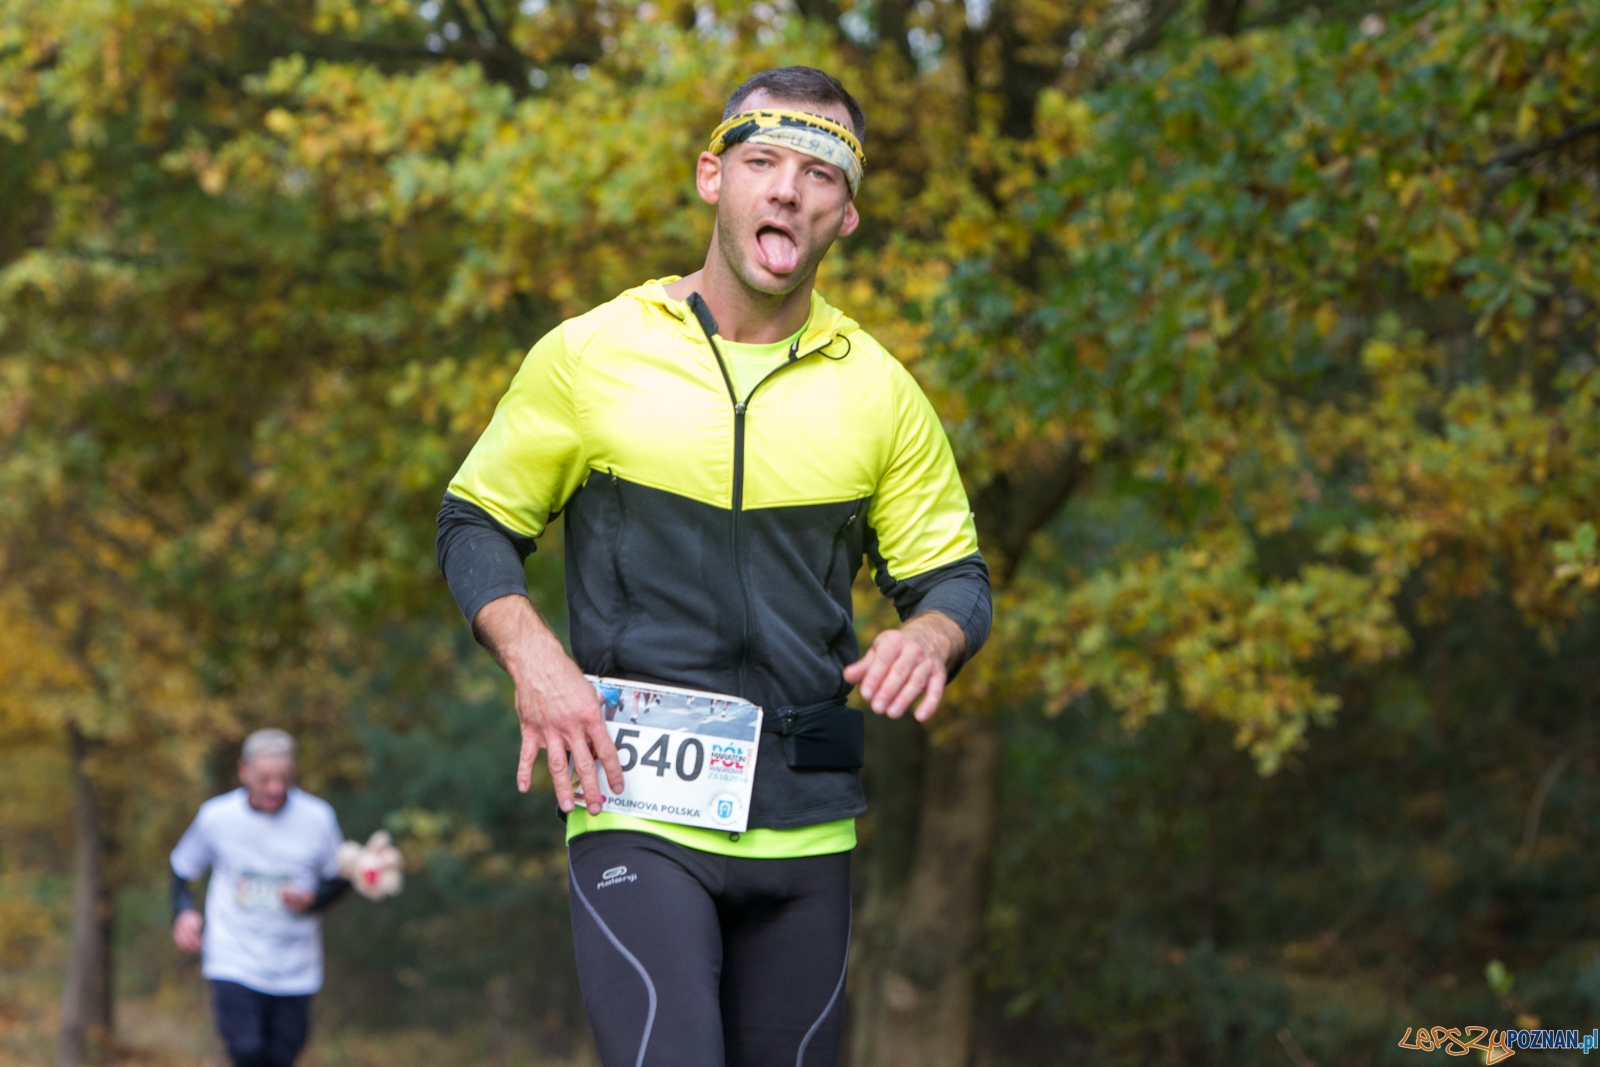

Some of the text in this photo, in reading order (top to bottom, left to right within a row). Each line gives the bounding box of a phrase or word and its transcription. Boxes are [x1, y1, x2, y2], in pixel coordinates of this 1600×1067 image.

[615, 728, 704, 782] 540
[608, 796, 658, 811] POLINOVA
[661, 804, 700, 818] POLSKA
